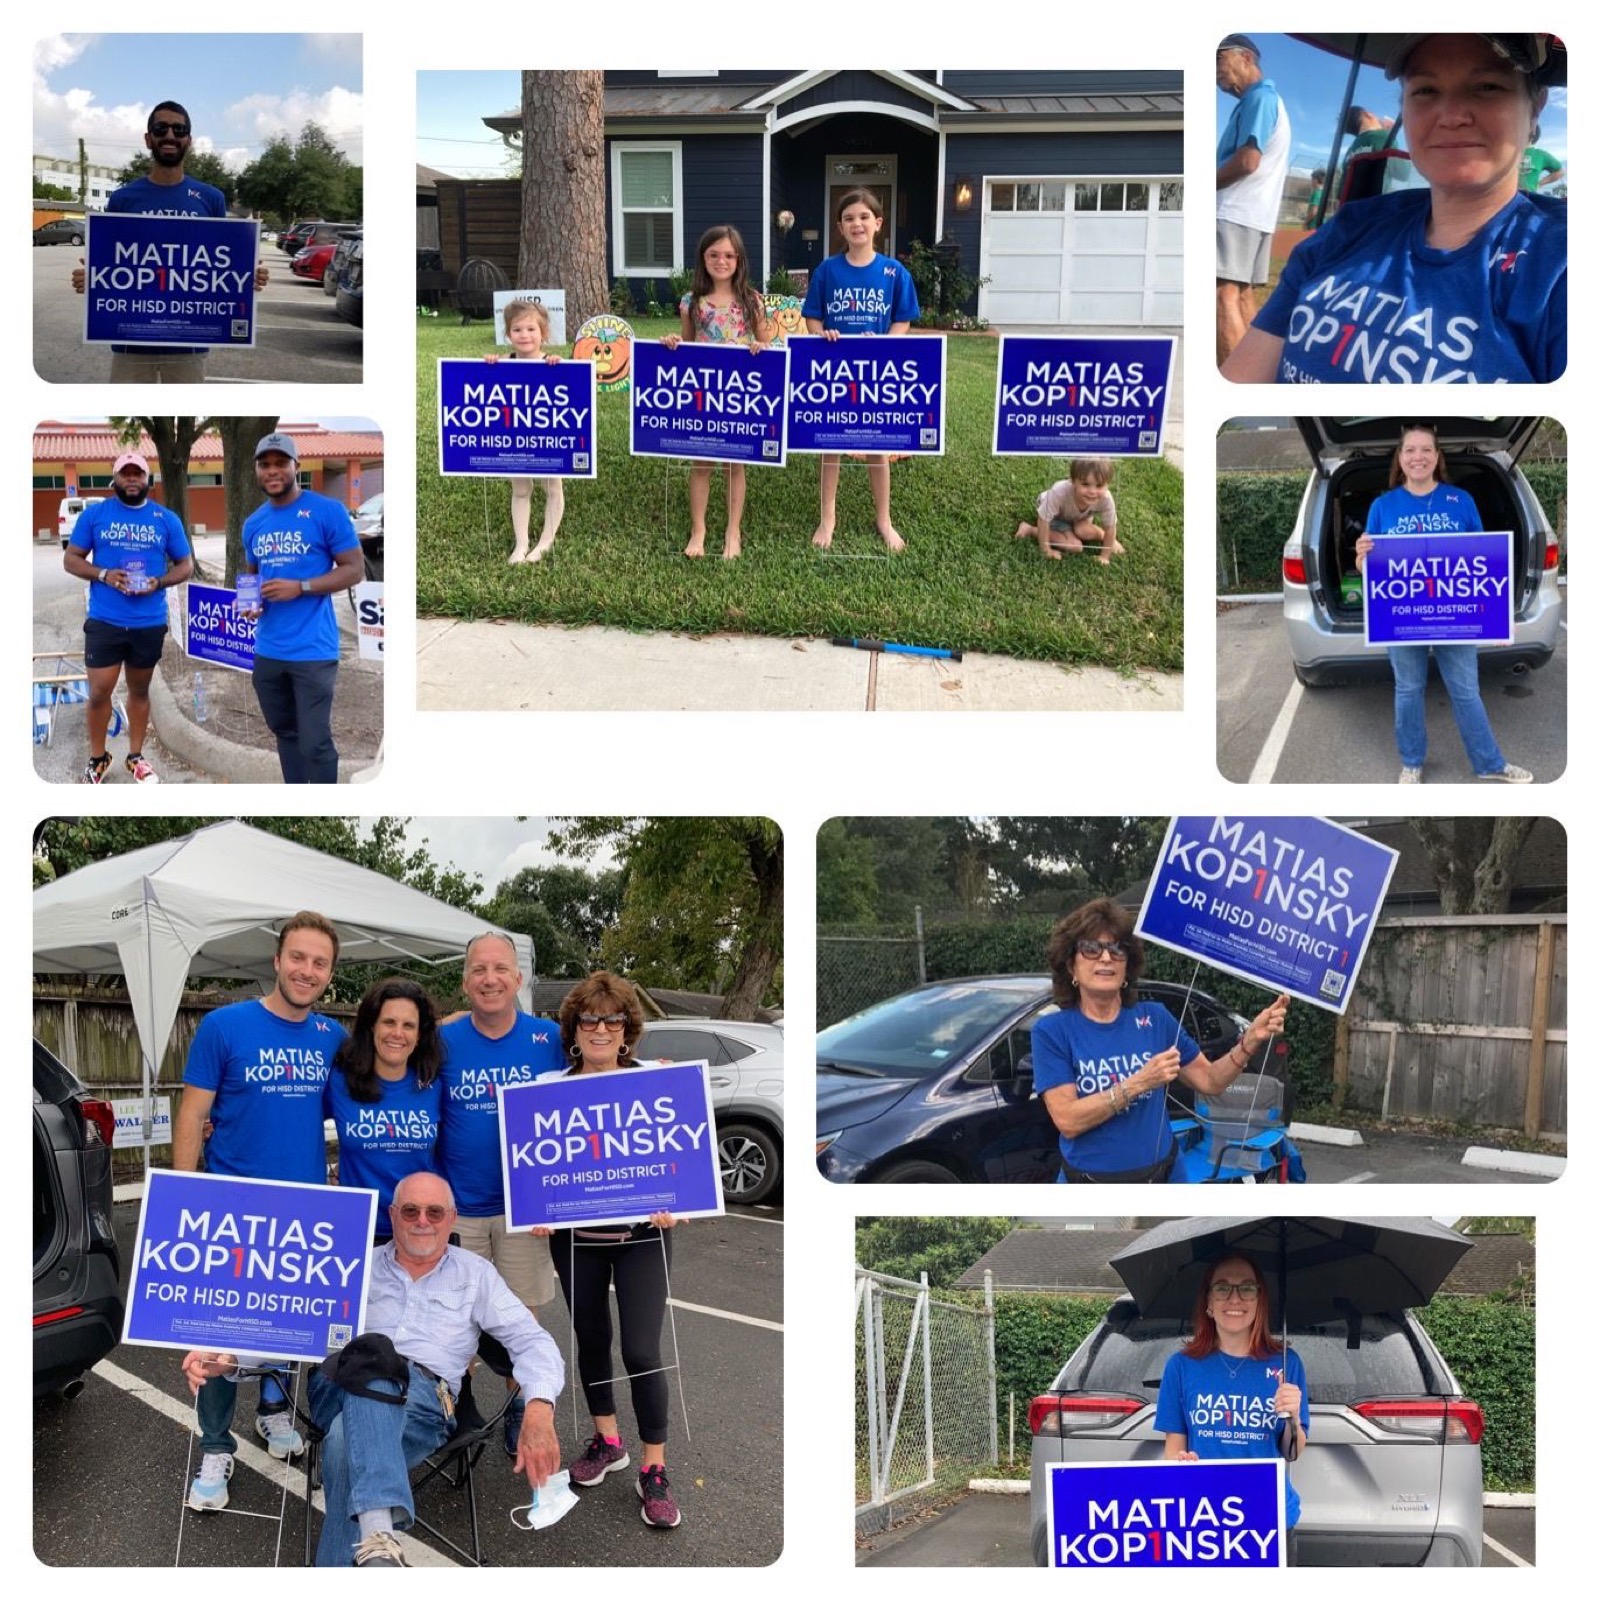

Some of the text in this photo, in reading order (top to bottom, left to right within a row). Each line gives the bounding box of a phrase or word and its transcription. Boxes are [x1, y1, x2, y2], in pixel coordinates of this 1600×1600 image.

[115, 241, 231, 268] MATIAS
[90, 265, 251, 293] KOP1NSKY
[883, 266, 897, 277] MK
[833, 287, 885, 301] MATIAS
[96, 298, 245, 316] FOR HISD DISTRICT 1
[826, 299, 891, 315] KOP1NSKY
[1305, 274, 1480, 362] MATIAS
[581, 317, 633, 338] SHINE
[1288, 304, 1508, 384] OP1NSK
[656, 365, 762, 393] MATIAS
[810, 360, 918, 382] MATIAS
[1026, 361, 1144, 384] MATIAS
[464, 383, 570, 406] MATIAS
[635, 386, 781, 417] KOP1NSKY
[790, 381, 938, 405] KOP1NSKY
[1001, 384, 1164, 408] KOP1NSKY
[443, 405, 589, 430] KOP1NSKY
[640, 415, 775, 437] FOR HISD DISTRICT 1
[794, 411, 933, 425] FOR HISD DISTRICT 1
[1006, 413, 1155, 428] FOR HISD DISTRICT 1
[449, 434, 585, 449] FOR HISD DISTRICT 1
[110, 521, 155, 533] MATIAS
[1398, 512, 1449, 526] MATIAS
[252, 541, 311, 556] OP1NSKY
[258, 531, 302, 545] MATIAS
[1388, 556, 1488, 578] MATIAS
[1370, 577, 1508, 600] KOP1NSKY
[359, 599, 384, 626] S
[1392, 604, 1485, 615] FOR HISD DISTRICT 1
[188, 612, 258, 639] KOP1NSK
[190, 631, 255, 654] FOR HISD DISTRIC
[1208, 816, 1354, 900] MATIAS
[1167, 833, 1368, 939] KOP1NSKY
[1165, 879, 1207, 912] FOR
[1209, 897, 1254, 928] HISD
[1257, 917, 1339, 963] DISTRICT
[1341, 950, 1349, 968] 1
[532, 1032, 548, 1043] MK
[259, 1048, 324, 1065] MATIAS
[1078, 1051, 1152, 1075] MATIAS
[462, 1065, 532, 1084] MATIAS
[261, 1085, 276, 1093] FOR
[294, 1085, 320, 1093] DISTRICT
[359, 1109, 430, 1124] MATIAS
[480, 1102, 497, 1110] HISD
[533, 1096, 676, 1138] MATIAS
[114, 1115, 169, 1128] WALER
[511, 1122, 708, 1169] KOP1NSKY
[542, 1163, 676, 1187] FOR HISD DISTRICT 1
[177, 1208, 335, 1252] MATIAS
[141, 1238, 361, 1288] KOP1NSKY
[145, 1282, 350, 1319] FOR HISD DISTRICT 1
[1196, 1393, 1276, 1413] MATIAS
[1198, 1429, 1213, 1438] FOR
[1214, 1430, 1232, 1439] HISD
[1233, 1431, 1265, 1440] DISTRICT
[1088, 1495, 1246, 1531] MATIAS
[1060, 1529, 1279, 1565] KOP1NSKY
